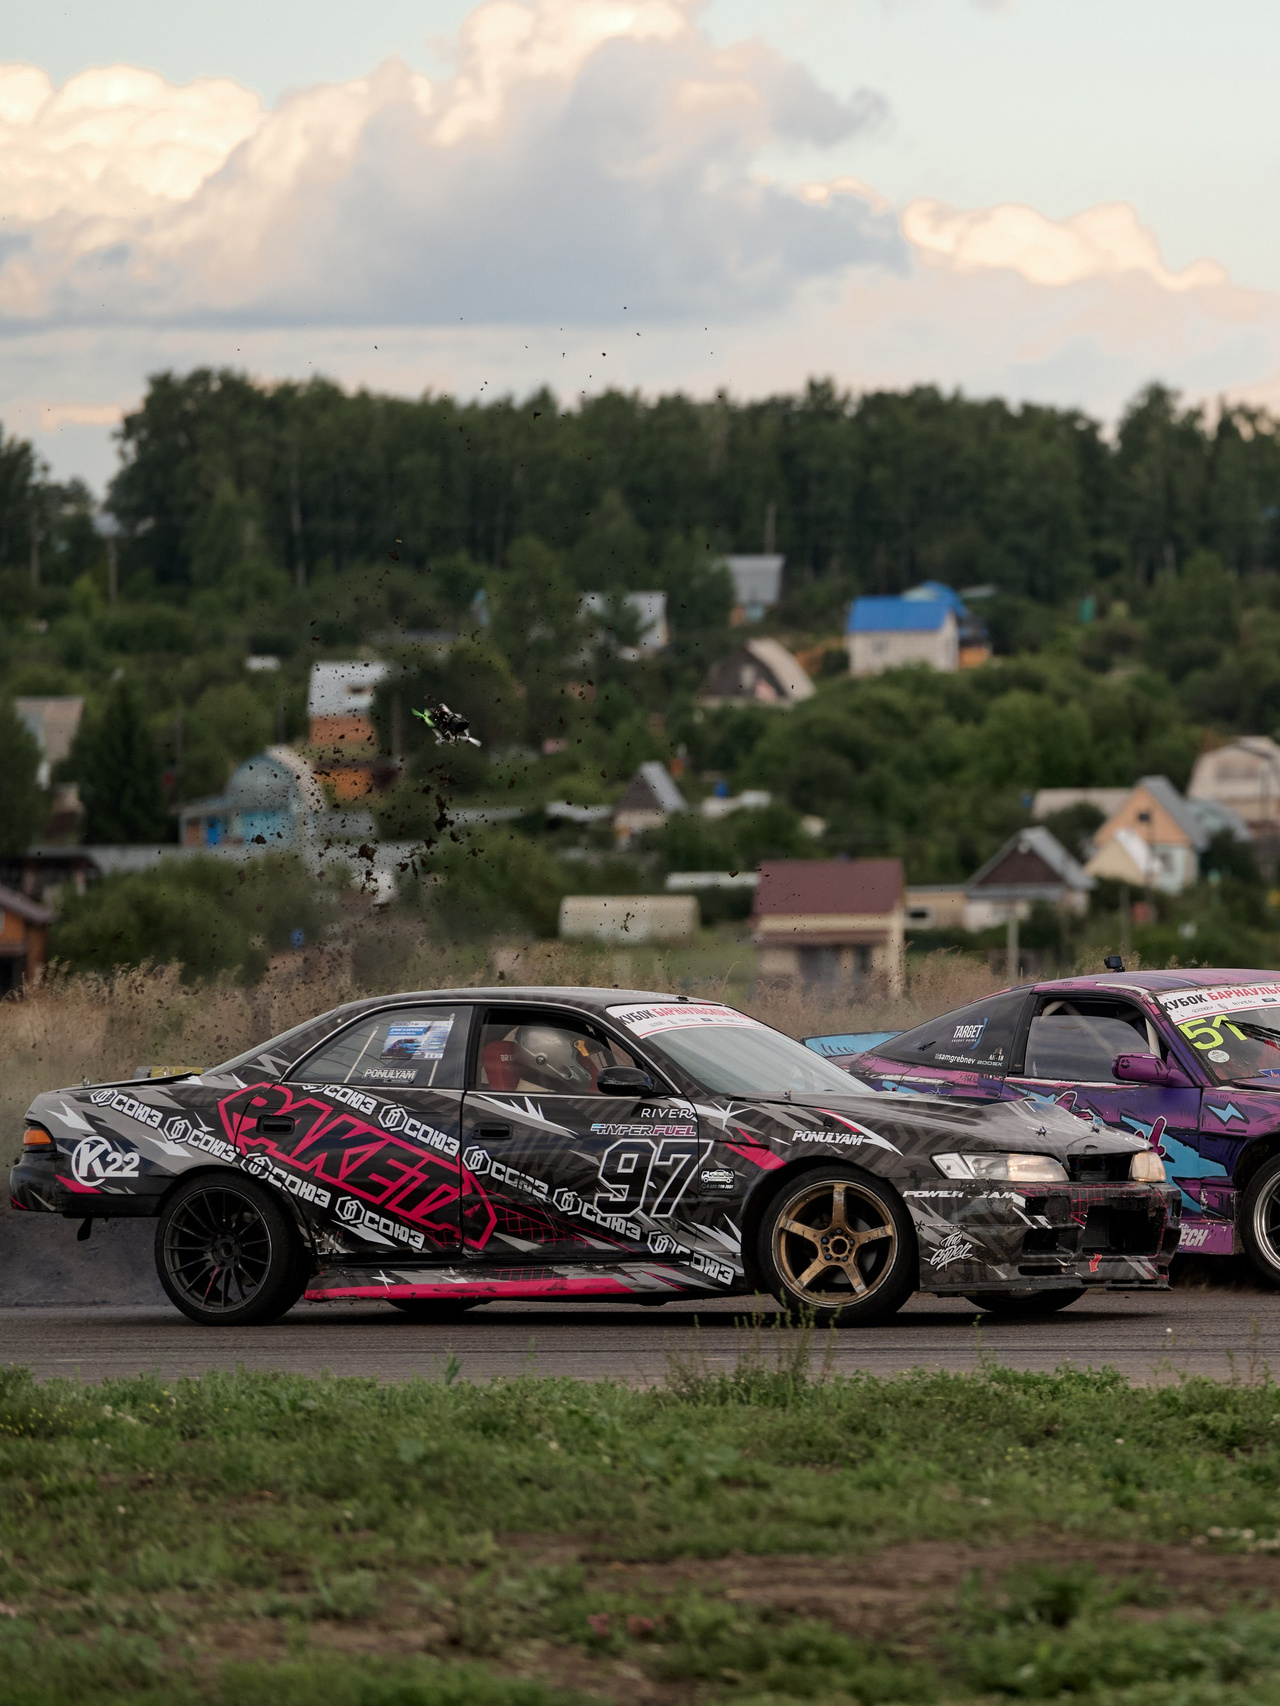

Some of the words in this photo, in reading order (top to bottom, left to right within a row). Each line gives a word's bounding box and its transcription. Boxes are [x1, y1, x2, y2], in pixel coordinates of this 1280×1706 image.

[1161, 994, 1208, 1012] КУБОК
[616, 1009, 657, 1026] КУБОК
[953, 1025, 984, 1038] TARGET
[1178, 1014, 1248, 1050] 51
[934, 1053, 976, 1065] @samgrebnev
[363, 1068, 418, 1081] PONULYAM
[323, 1085, 377, 1115] СОЮЗ
[111, 1095, 163, 1129] СОЮЗ
[641, 1108, 694, 1120] RIVER
[187, 1130, 240, 1164] СОЮЗ
[404, 1118, 460, 1157] СОЮЗ
[792, 1130, 865, 1146] PONULYAM
[268, 1167, 331, 1208] СОЮЗ
[594, 1138, 715, 1218] 97
[902, 1190, 964, 1198] POWER
[363, 1210, 425, 1250] СОЮЗ
[1178, 1228, 1209, 1247] ECH
